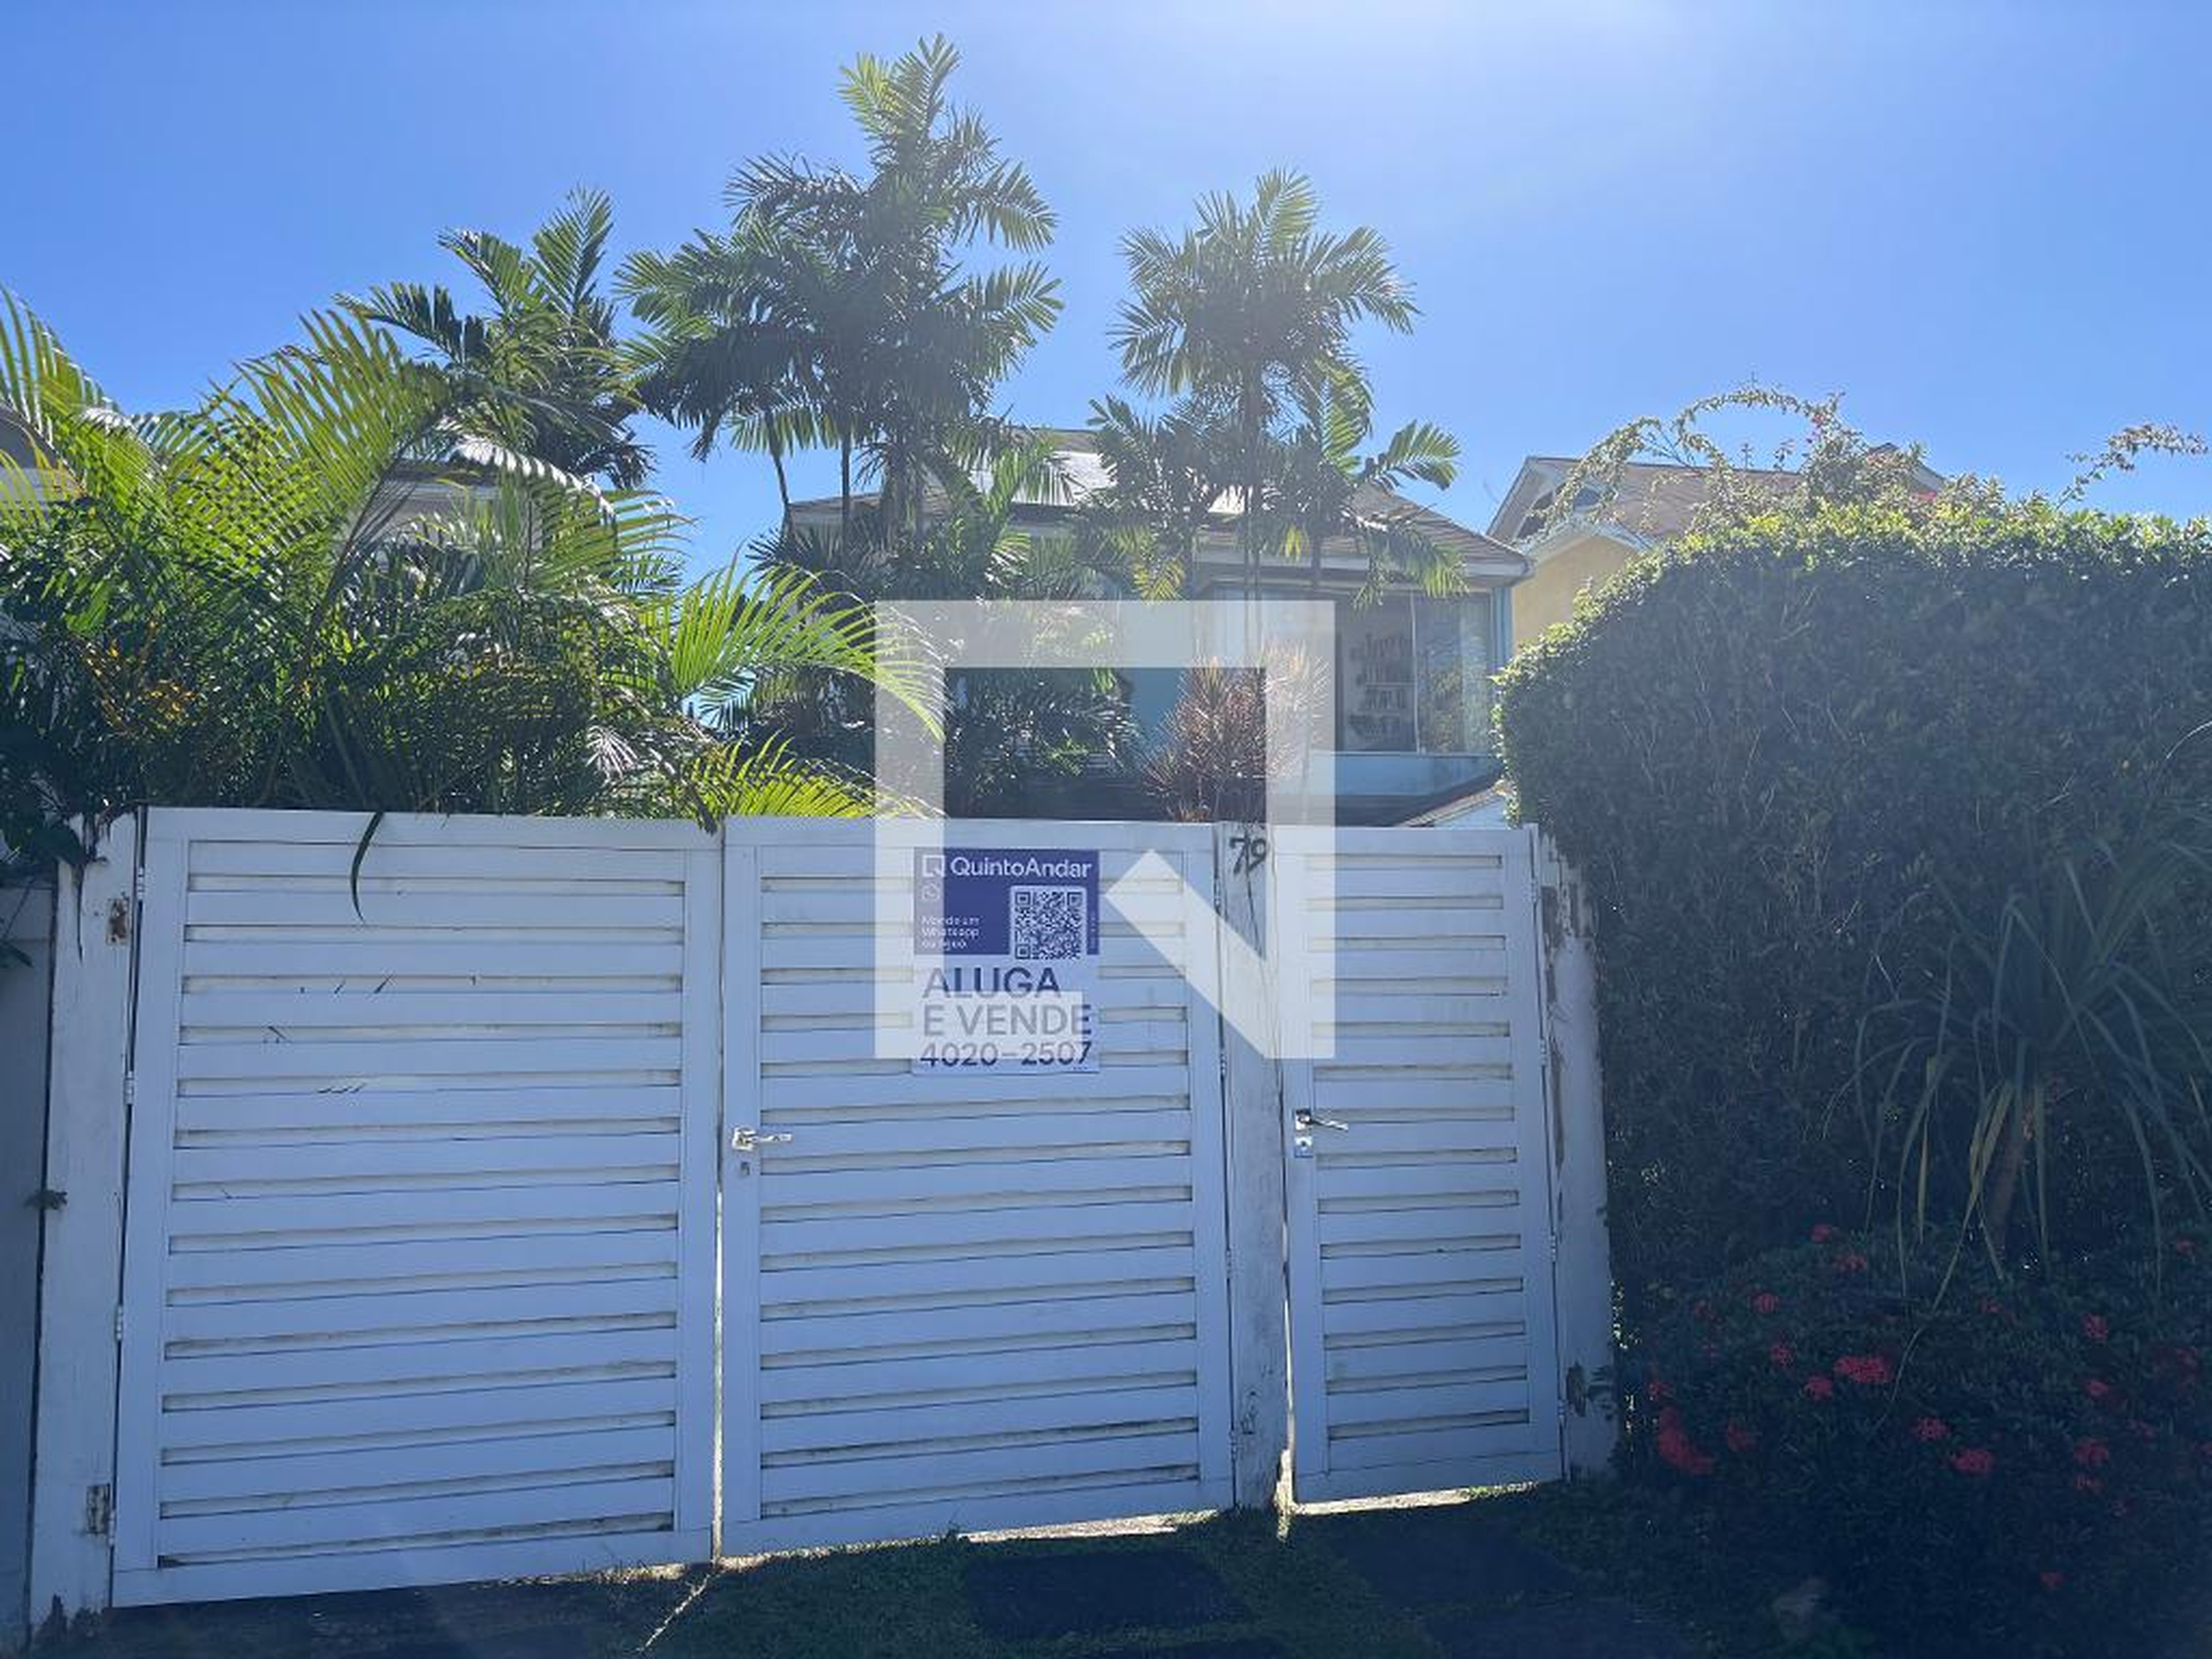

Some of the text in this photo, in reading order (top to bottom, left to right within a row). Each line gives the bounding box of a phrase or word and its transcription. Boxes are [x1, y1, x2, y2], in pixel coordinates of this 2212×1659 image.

[950, 857, 1092, 878] QuintoAndar
[1229, 838, 1268, 874] 79
[923, 967, 1061, 998] ALUGA
[924, 1004, 1092, 1037] E VENDE
[920, 1040, 1092, 1067] 4020-2507
